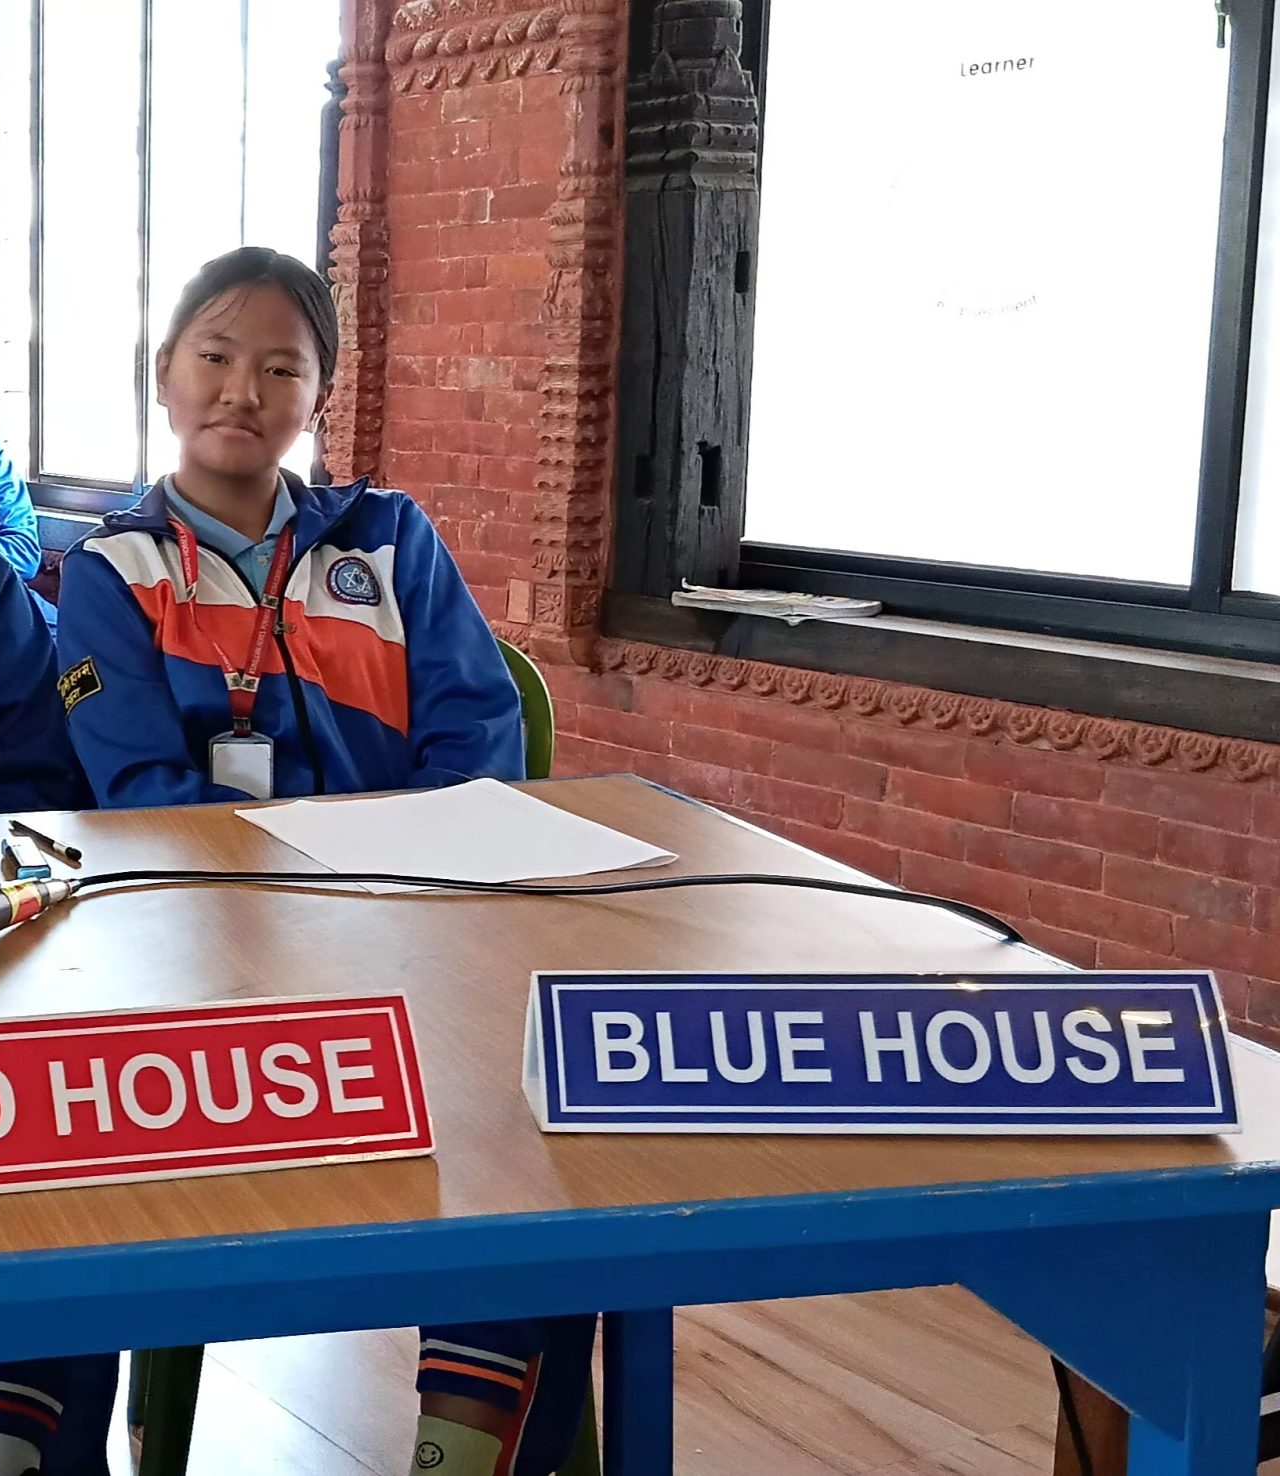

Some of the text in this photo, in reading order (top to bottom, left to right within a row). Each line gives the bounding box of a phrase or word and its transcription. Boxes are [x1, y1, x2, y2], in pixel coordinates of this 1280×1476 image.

[960, 57, 1035, 77] Learner
[592, 1010, 1184, 1083] BLUE HOUSE
[49, 1038, 384, 1135] HOUSE
